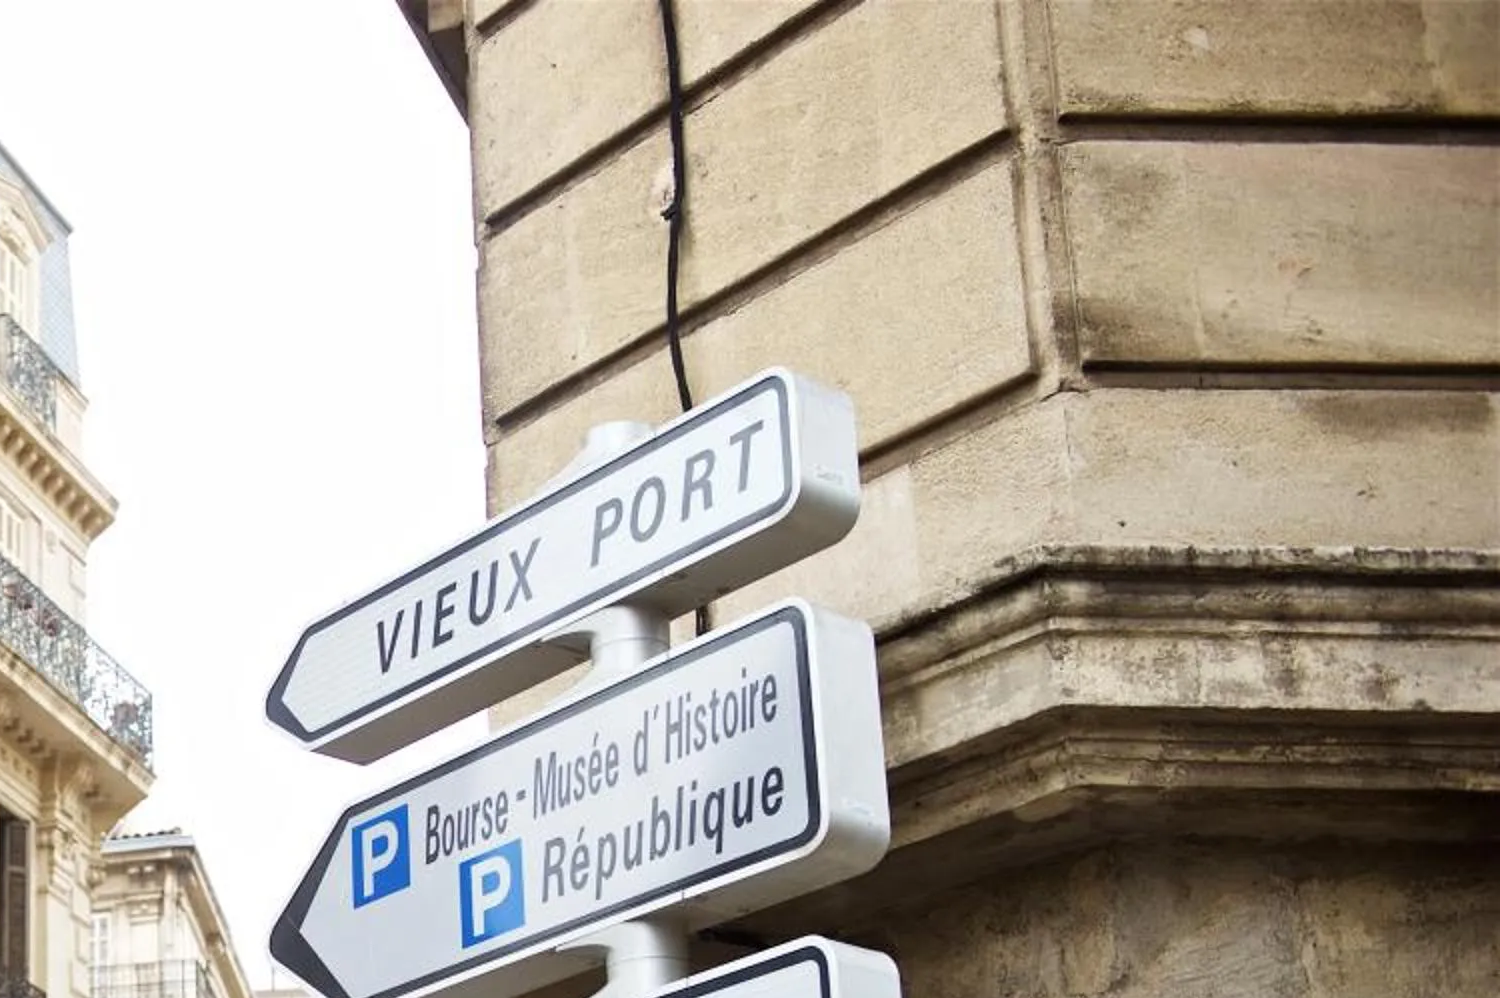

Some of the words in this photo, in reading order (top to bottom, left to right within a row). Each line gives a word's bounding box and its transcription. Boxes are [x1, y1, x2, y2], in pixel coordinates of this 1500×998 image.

[376, 537, 542, 675] VIEUX
[590, 420, 764, 567] PORT
[361, 821, 399, 898] P
[425, 788, 509, 865] Bourse
[532, 732, 619, 819] Musée
[471, 854, 512, 939] P
[541, 765, 784, 903] République
